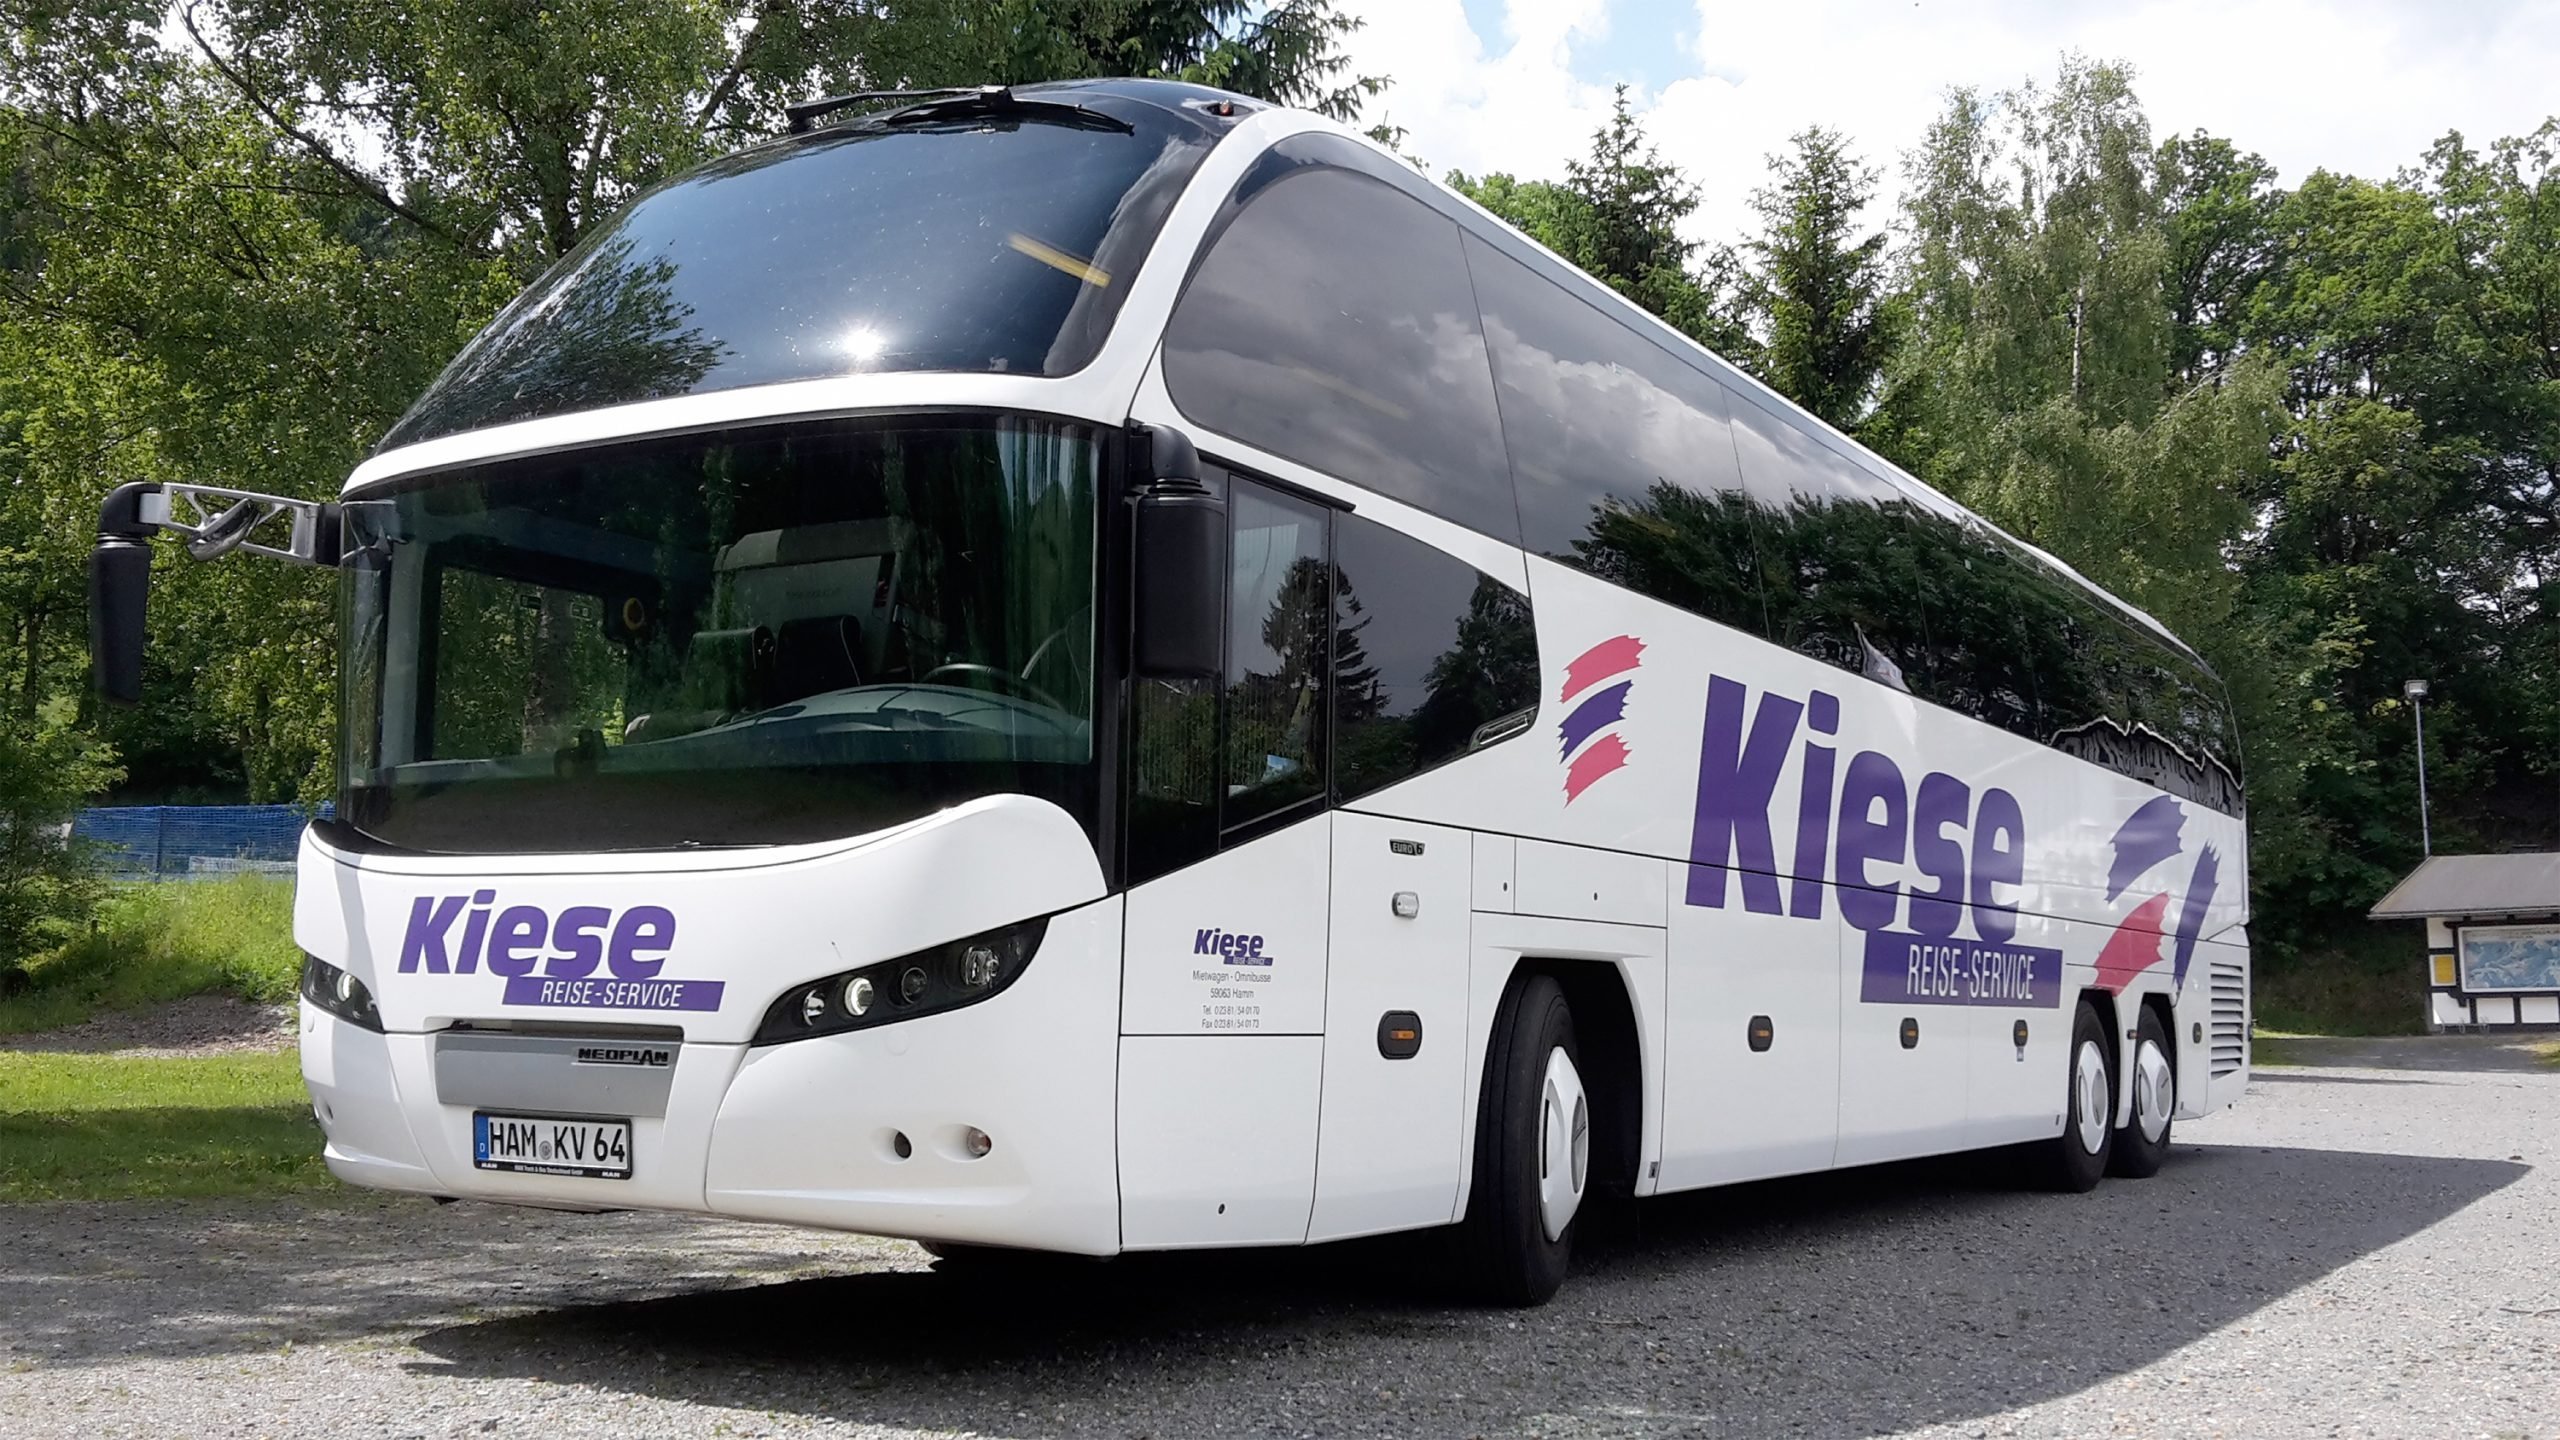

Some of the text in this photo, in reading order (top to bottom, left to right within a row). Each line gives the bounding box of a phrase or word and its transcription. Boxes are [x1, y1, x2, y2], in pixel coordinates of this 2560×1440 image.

[1685, 673, 2025, 944] Kiese
[397, 889, 676, 979] Kiese
[1194, 928, 1264, 957] Kiese
[1192, 970, 1229, 984] Mietwagen
[1234, 970, 1272, 983] Omnibusse
[1906, 943, 2036, 1000] REISE-SERVICE
[540, 980, 684, 1008] REISE-SERVICE
[1210, 987, 1255, 999] 59063 Hamm
[1202, 1018, 1212, 1028] Fax
[578, 1048, 669, 1066] NEOPLAN
[479, 1121, 626, 1163] D HAM KV 64
